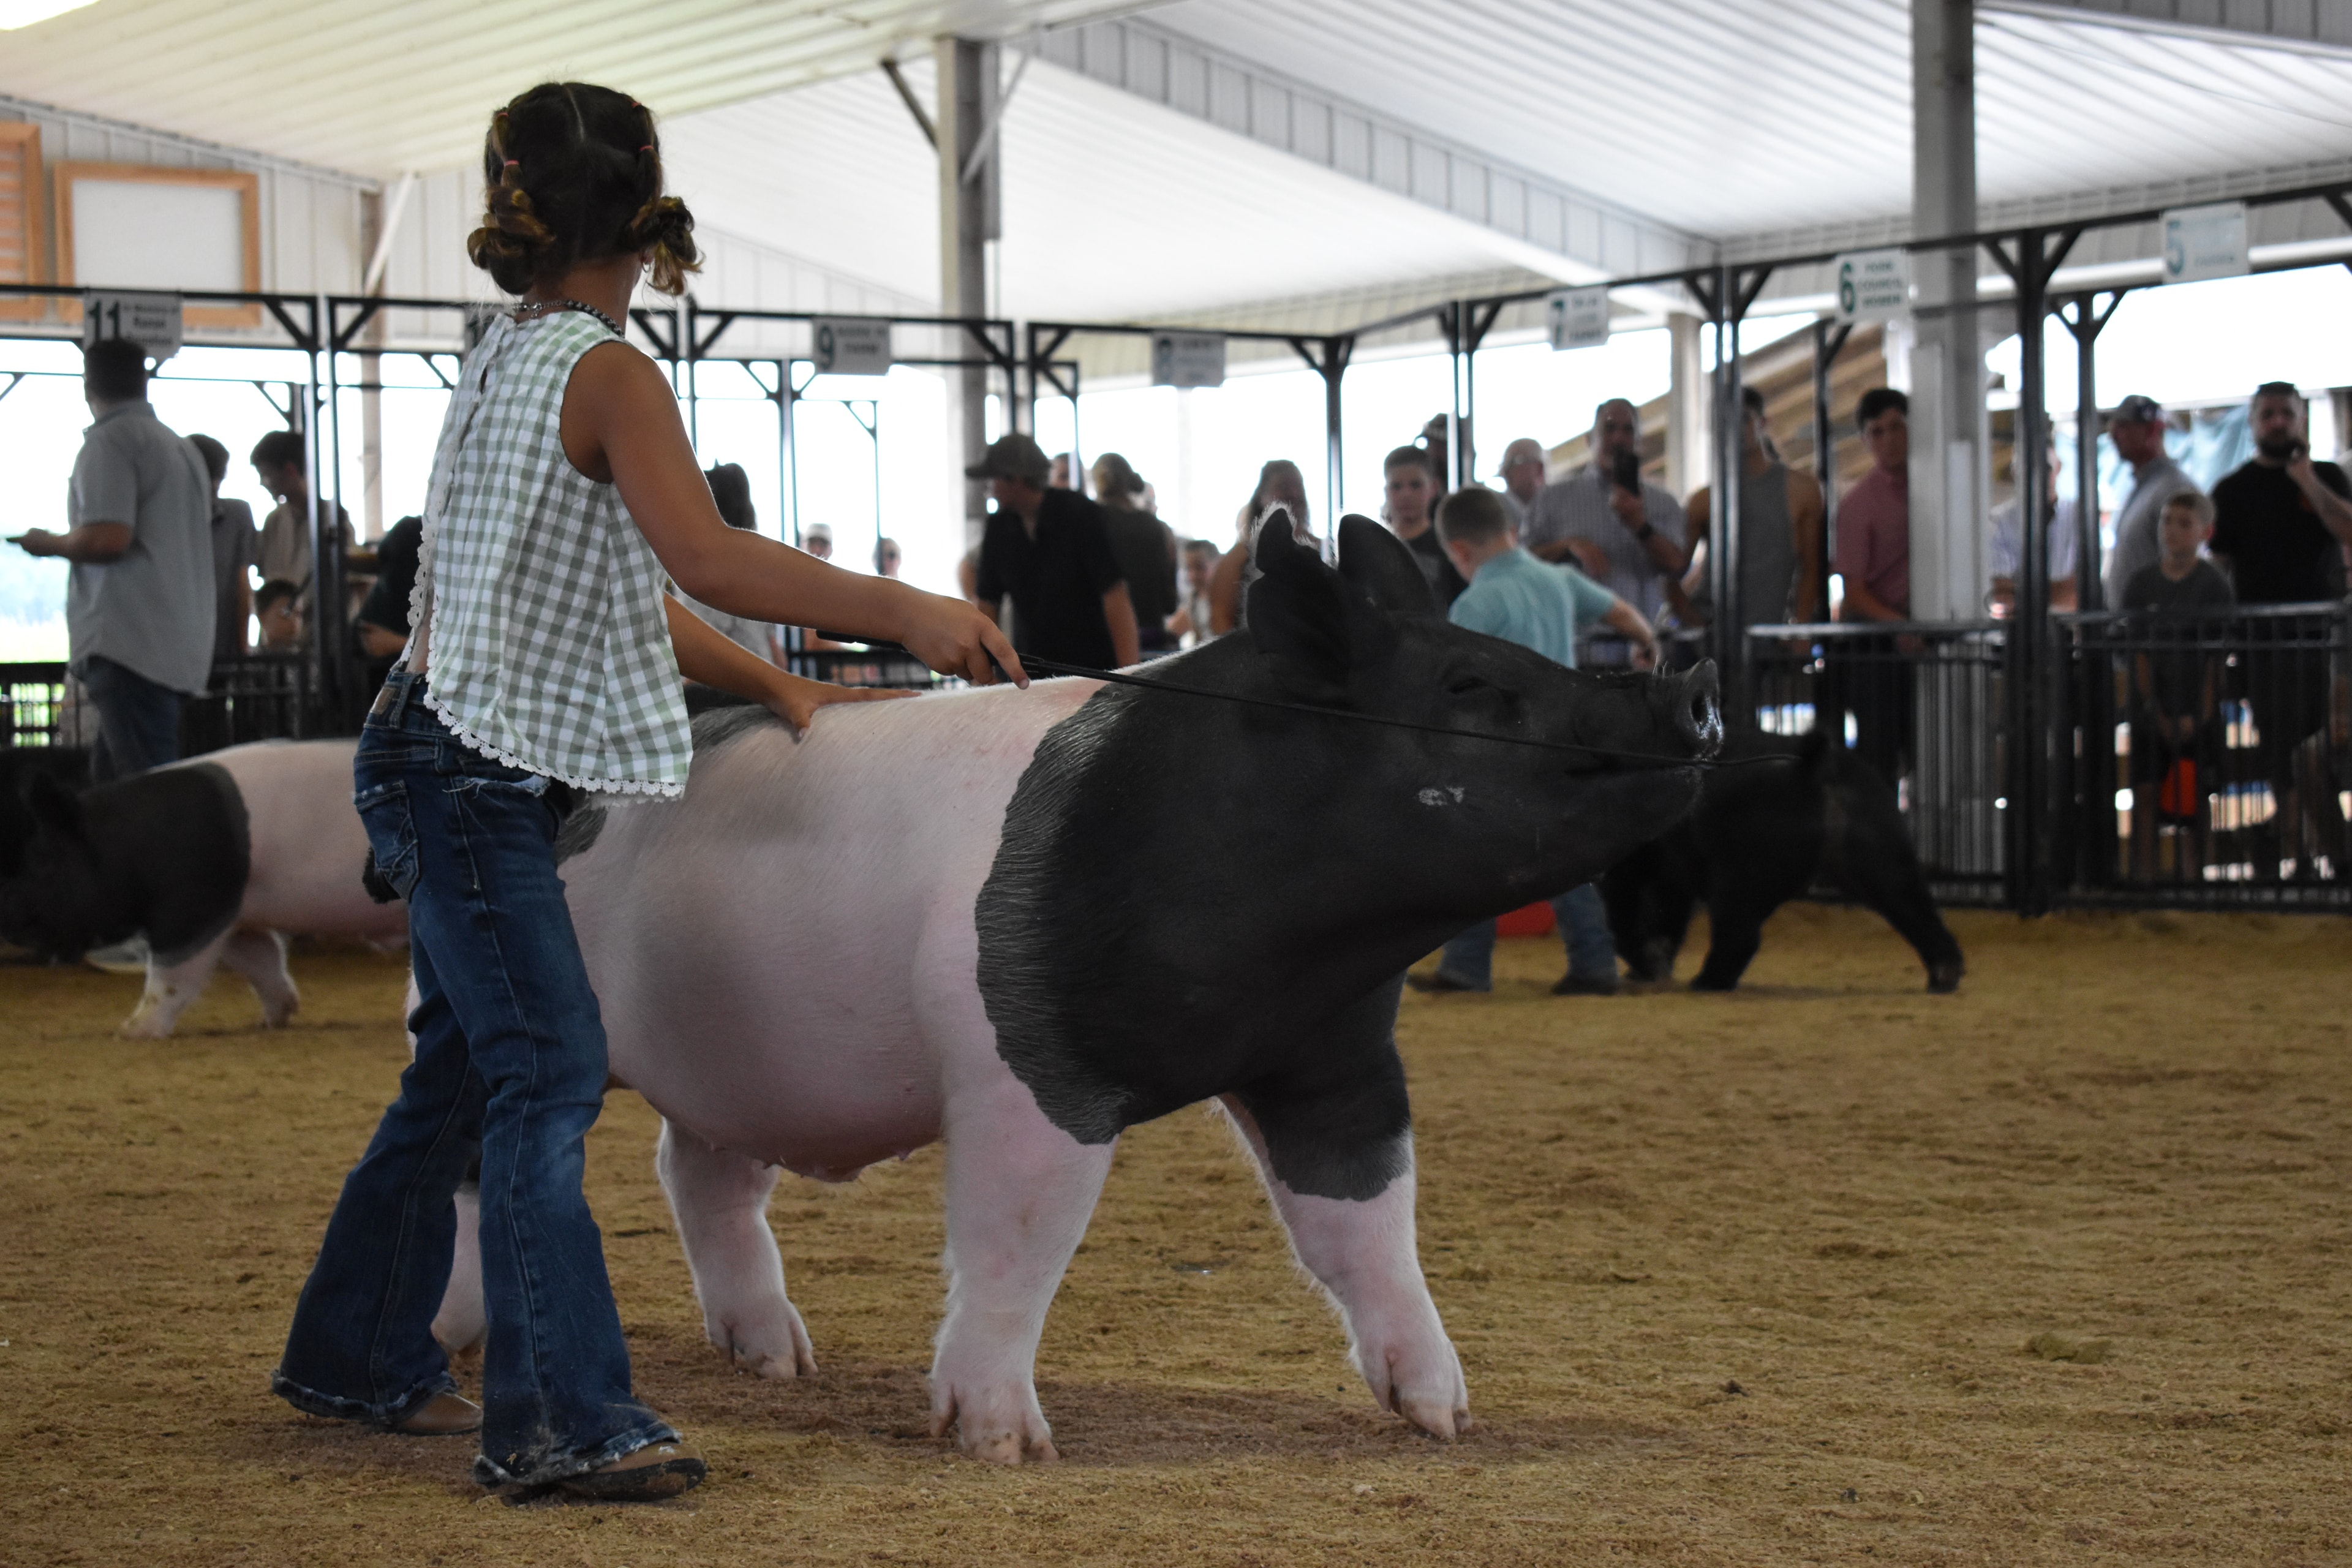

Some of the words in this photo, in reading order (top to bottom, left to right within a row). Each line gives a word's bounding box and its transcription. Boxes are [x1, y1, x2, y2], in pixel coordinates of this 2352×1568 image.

[2167, 220, 2184, 275] 5
[1840, 262, 1855, 313] 6
[88, 299, 120, 342] 11
[1551, 298, 1565, 345] 7
[818, 324, 834, 370] 9
